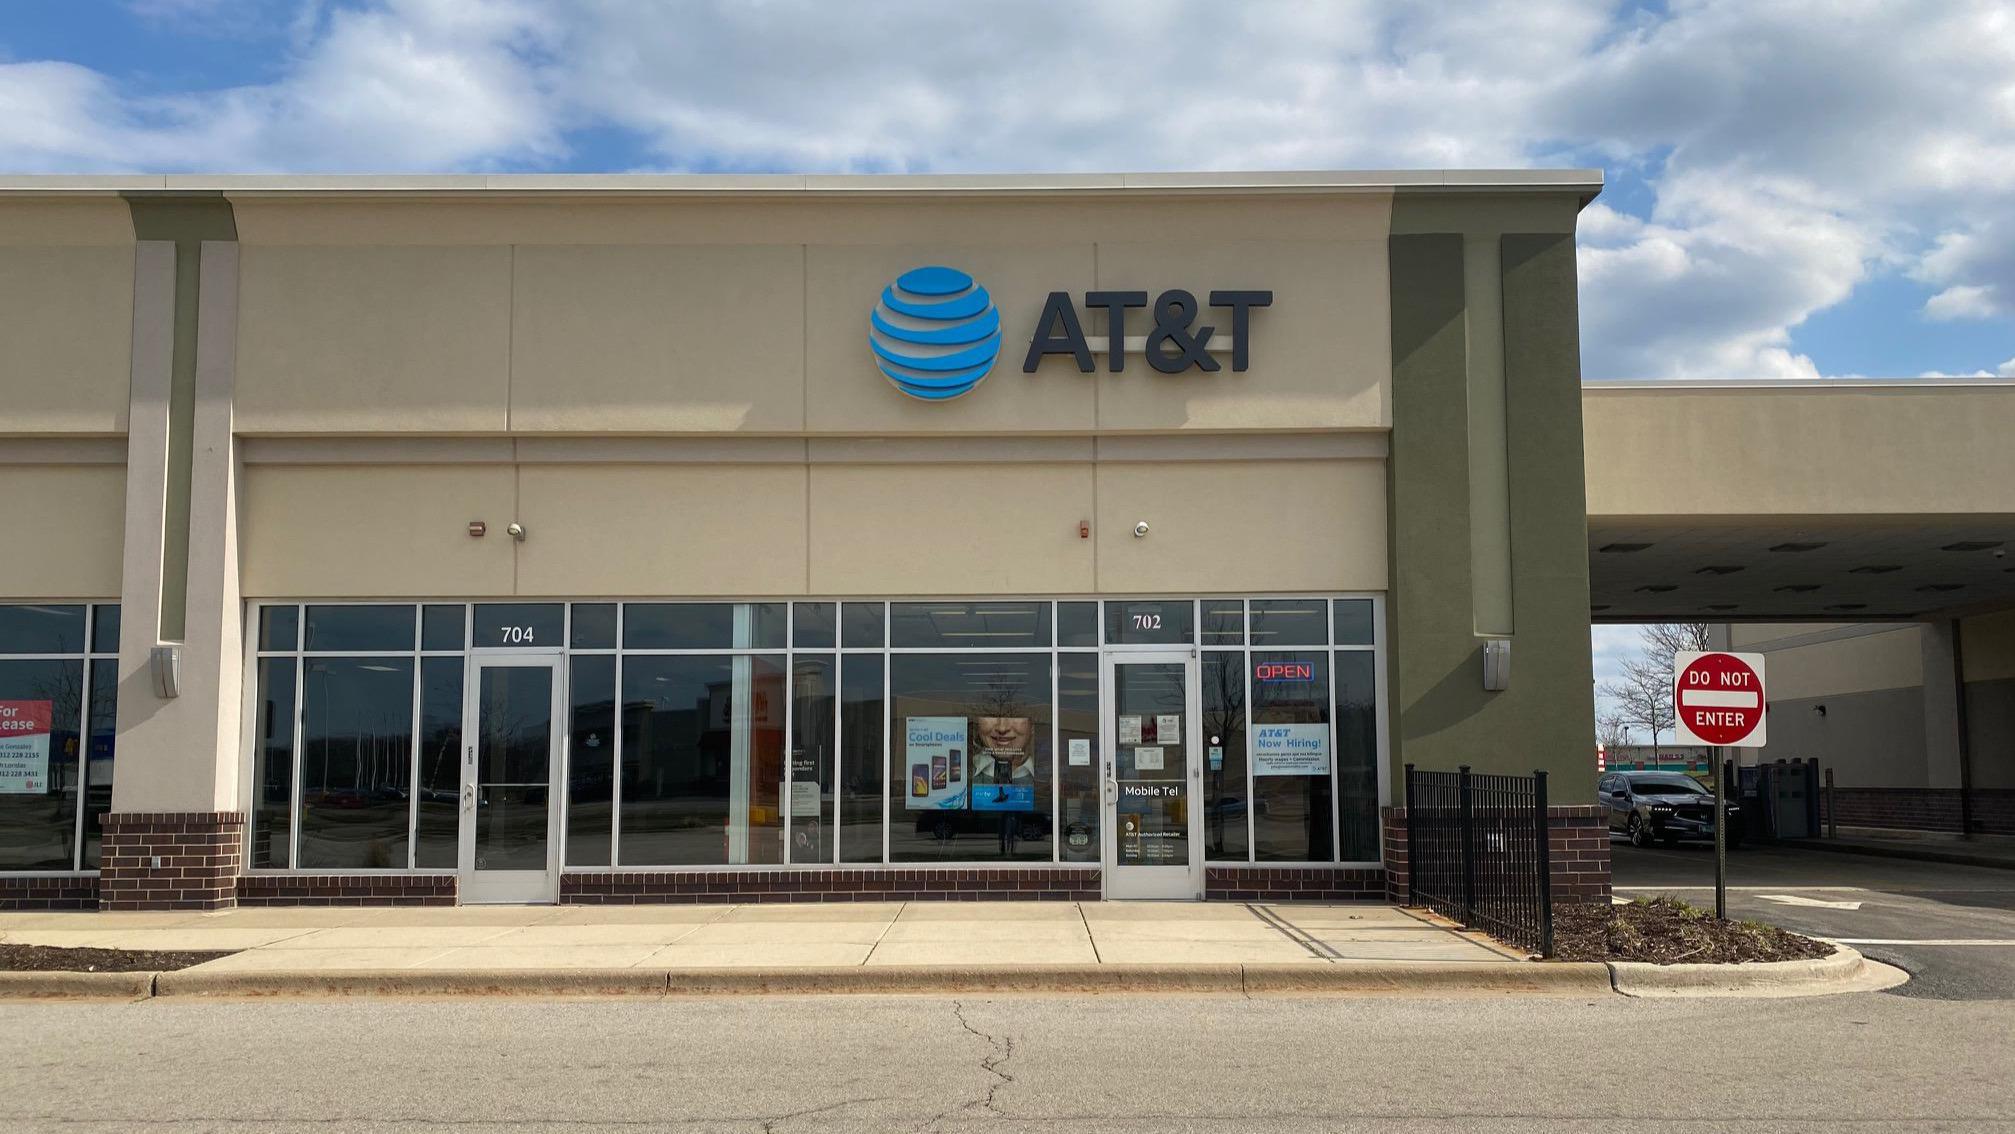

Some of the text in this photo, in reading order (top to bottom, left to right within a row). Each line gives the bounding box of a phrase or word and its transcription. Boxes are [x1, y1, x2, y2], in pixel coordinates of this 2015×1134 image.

[1023, 289, 1273, 373] AT&T
[1132, 614, 1162, 630] 702
[501, 626, 534, 643] 704
[1257, 665, 1310, 679] OPEN
[1689, 670, 1751, 687] DO NOT
[0, 720, 35, 730] ease
[1696, 711, 1745, 727] ENTER
[909, 731, 965, 742] Cool Deals
[1258, 728, 1291, 738] AT&T
[1258, 738, 1321, 750] Now Hiring!
[1125, 785, 1178, 796] Mobile Tel
